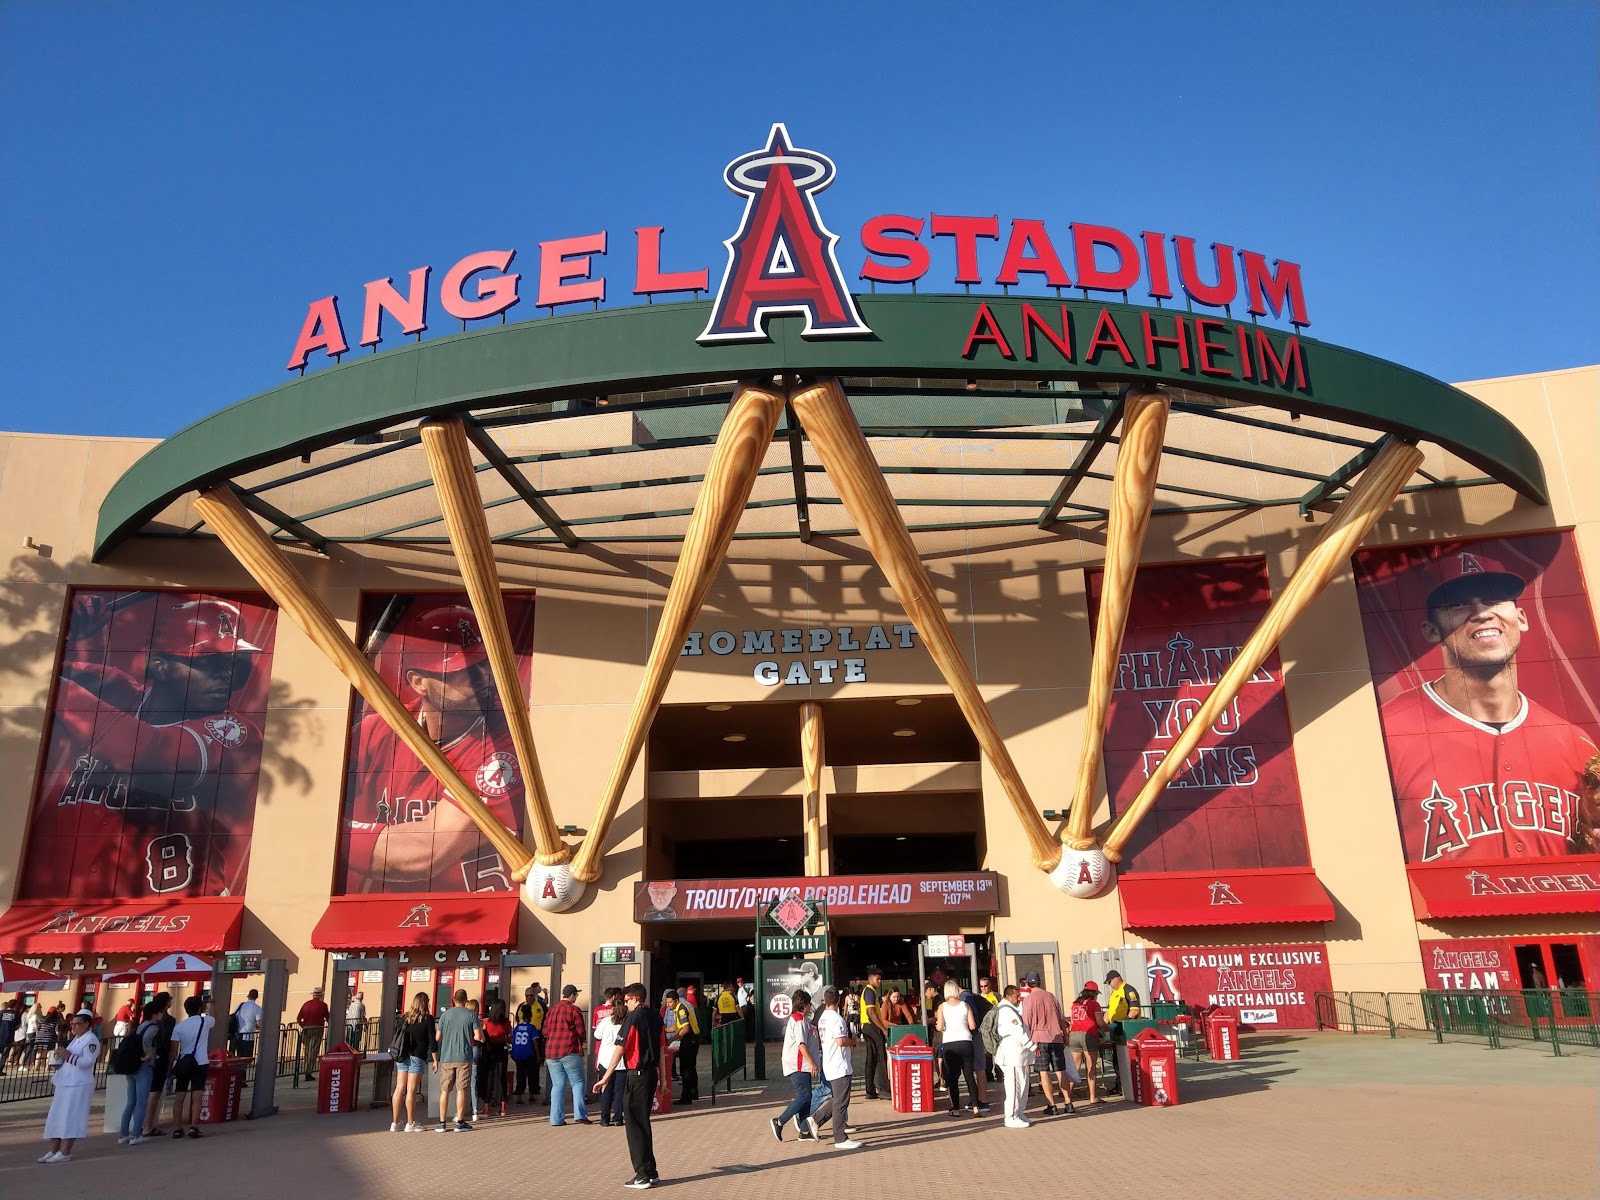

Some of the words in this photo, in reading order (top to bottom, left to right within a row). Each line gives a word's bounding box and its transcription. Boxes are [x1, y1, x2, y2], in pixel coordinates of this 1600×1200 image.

[286, 226, 709, 371] ANGEL
[859, 212, 1311, 328] STADIUM
[962, 300, 1306, 391] ANAHEIM
[680, 624, 918, 656] HOMEPLAT
[754, 658, 866, 686] GATE
[1421, 780, 1581, 863] ANGEL
[146, 833, 194, 893] 8
[919, 880, 975, 893] SEPTEMBER
[1465, 871, 1600, 896] ANGEL
[685, 887, 801, 910] TROUT/DUCKS
[804, 883, 912, 908] BOBBLEHEAD
[35, 909, 191, 934] ANGELS
[766, 938, 819, 951] DIRECTORY
[24, 957, 108, 971] WILL
[1182, 953, 1243, 968] STADIUM
[1250, 951, 1322, 966] EXCLUSIVE
[1433, 946, 1501, 970] ANGELS
[1217, 964, 1297, 991] ANGELS
[1438, 971, 1500, 990] TEAM
[772, 1002, 790, 1016] 45
[1208, 991, 1306, 1007] MERCHANDISE
[1072, 1005, 1088, 1021] 27
[514, 1031, 529, 1046] 66
[1221, 1026, 1232, 1060] RECYCLE
[329, 1068, 341, 1113] RECYCLE
[911, 1063, 921, 1112] RECYCLE
